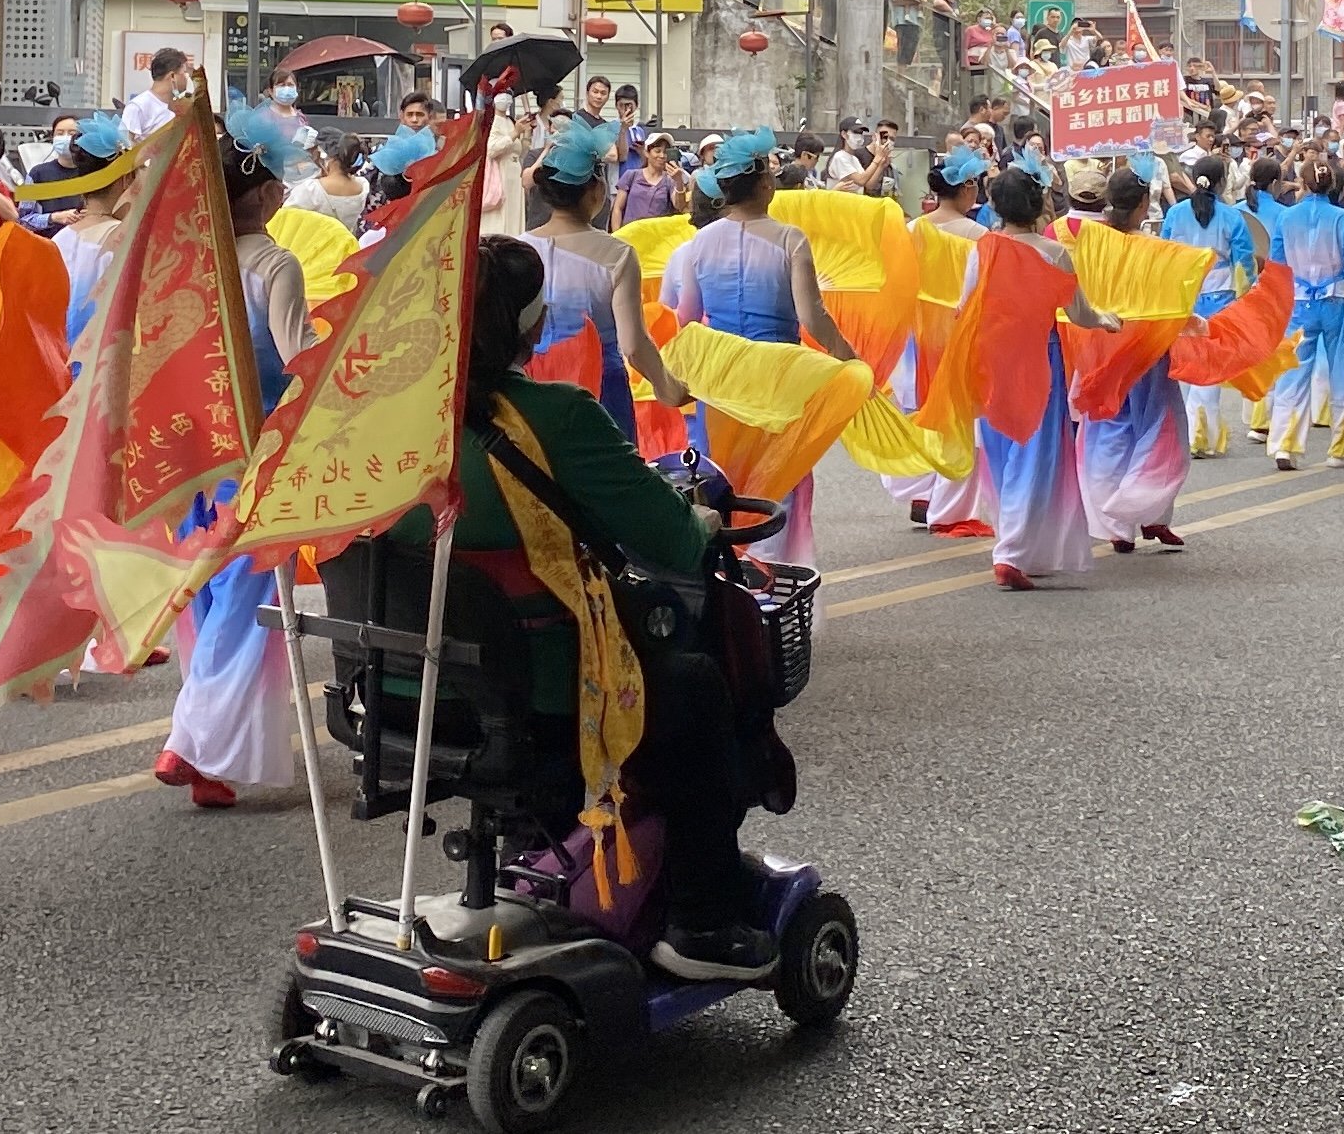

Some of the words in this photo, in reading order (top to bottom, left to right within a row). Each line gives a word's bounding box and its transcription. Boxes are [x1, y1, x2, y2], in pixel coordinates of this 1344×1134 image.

[1058, 78, 1171, 110] 西乡社区党群
[1067, 102, 1161, 131] 志愿舞蹈队
